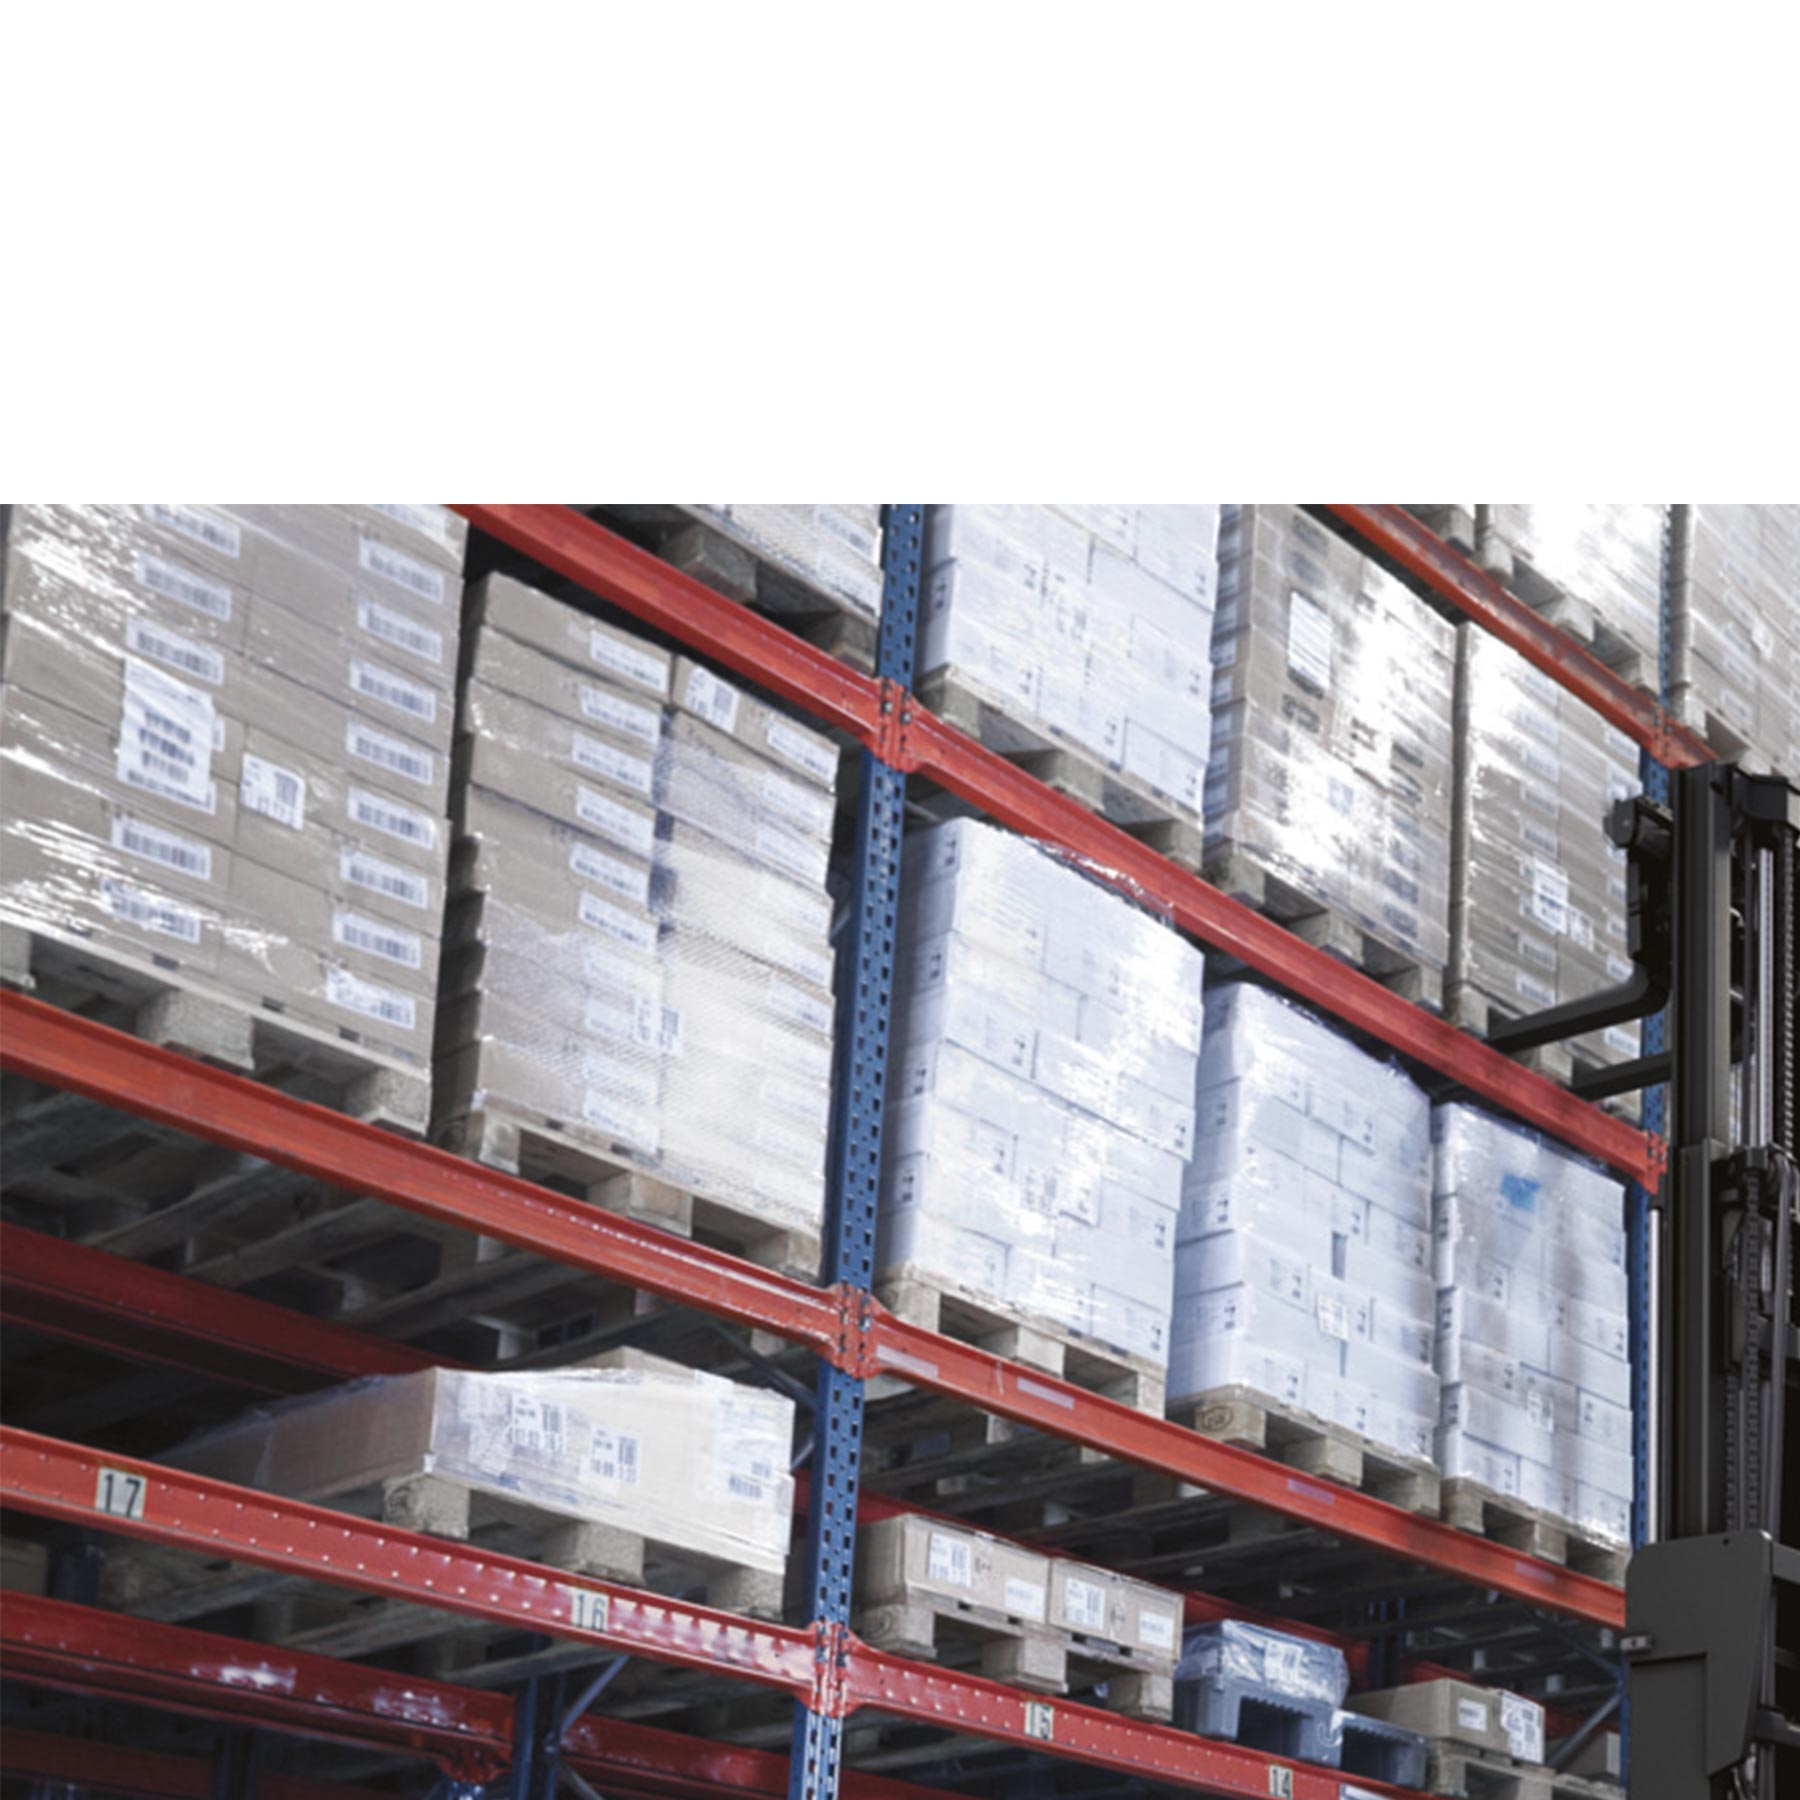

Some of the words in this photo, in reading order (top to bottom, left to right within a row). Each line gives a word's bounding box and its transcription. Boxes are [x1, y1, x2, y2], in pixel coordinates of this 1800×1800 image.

[104, 1473, 141, 1518] 17
[577, 1593, 606, 1633] 16
[1029, 1702, 1051, 1740] 15
[1271, 1768, 1291, 1799] 14
